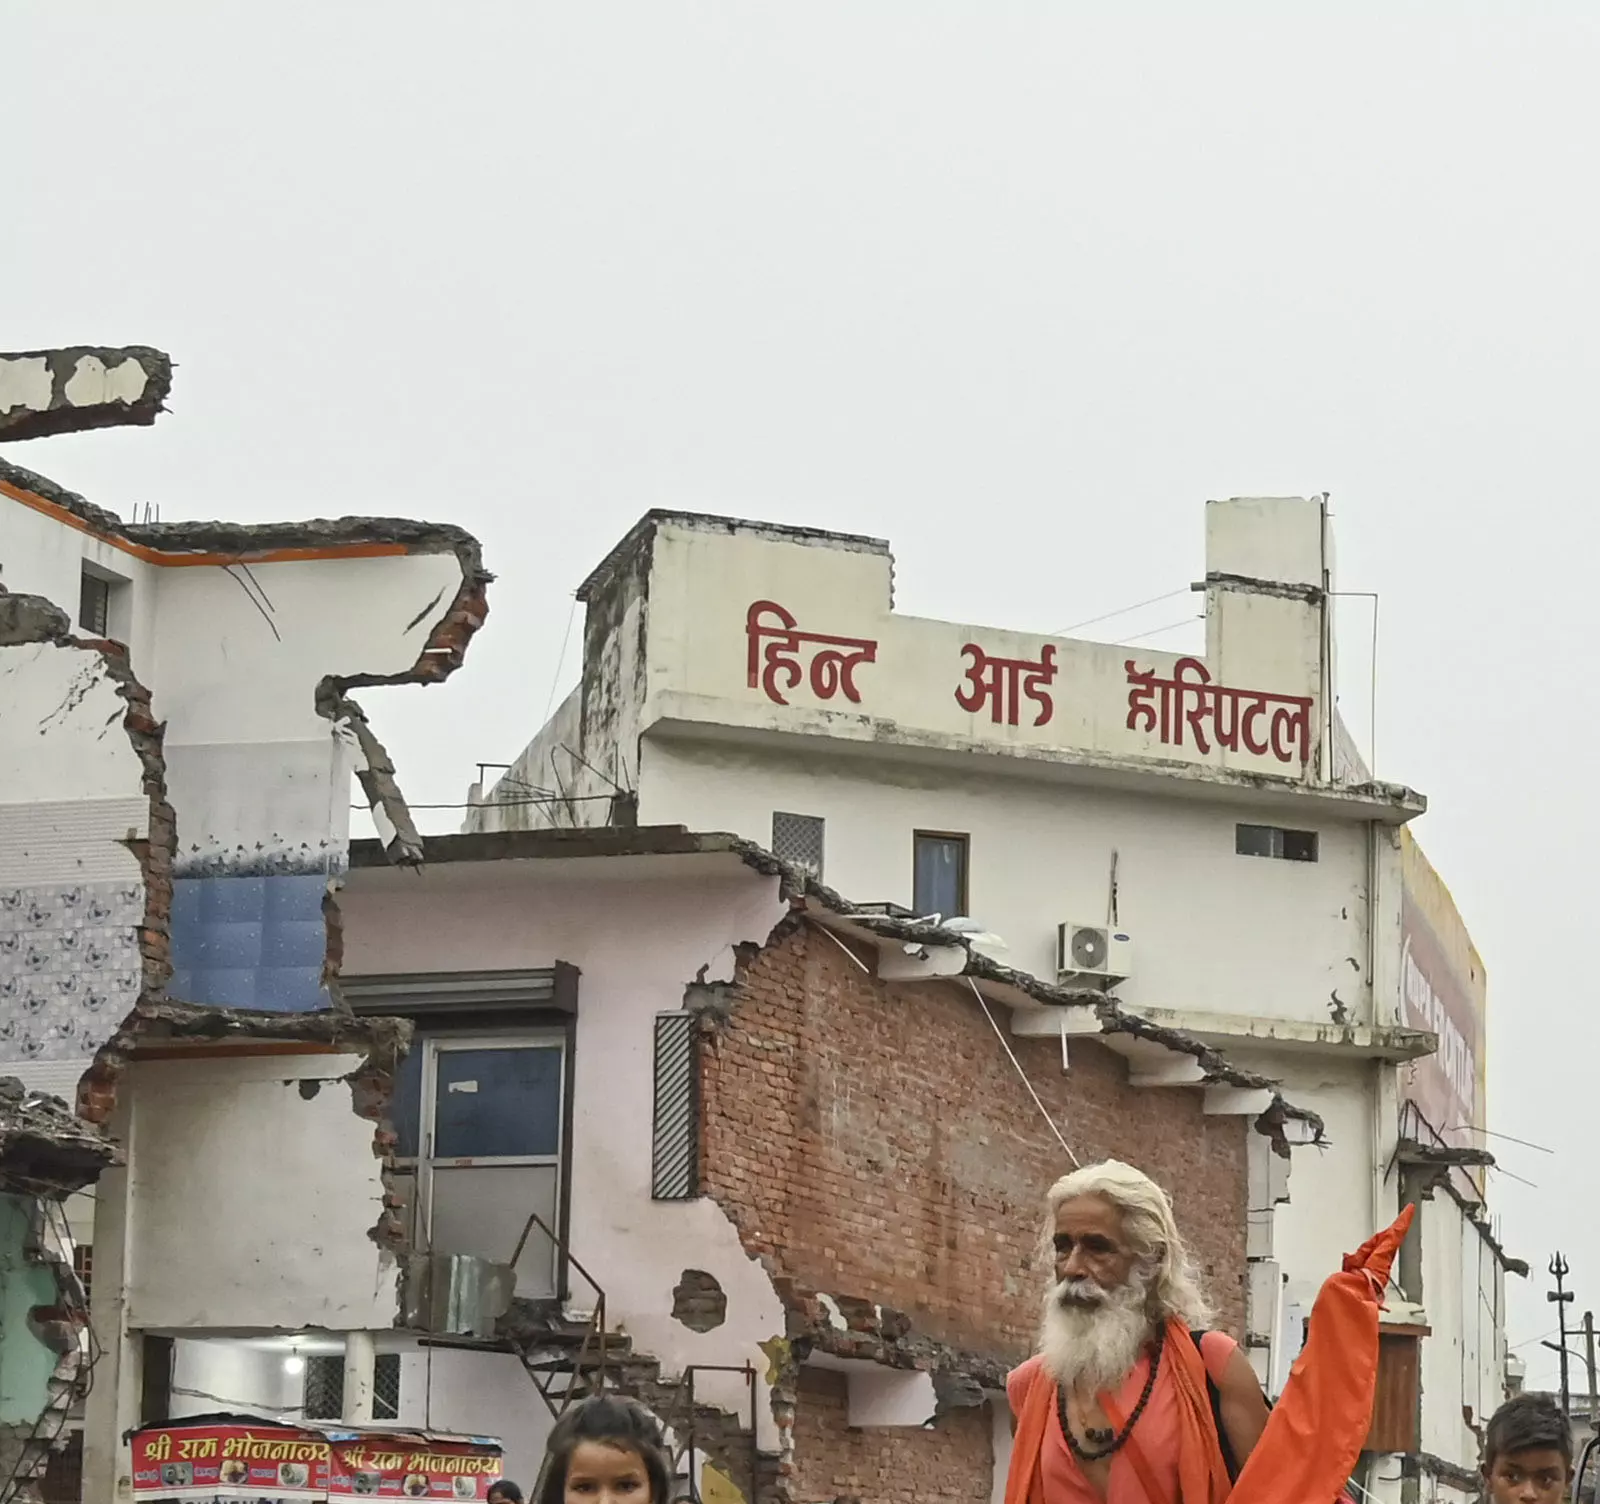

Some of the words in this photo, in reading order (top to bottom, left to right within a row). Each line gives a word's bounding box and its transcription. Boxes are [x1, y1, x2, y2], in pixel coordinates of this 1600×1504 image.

[954, 643, 1058, 727] आई
[144, 1434, 172, 1461] श्री
[178, 1438, 219, 1460] राम
[342, 1445, 367, 1469] श्री
[368, 1451, 405, 1470] राम
